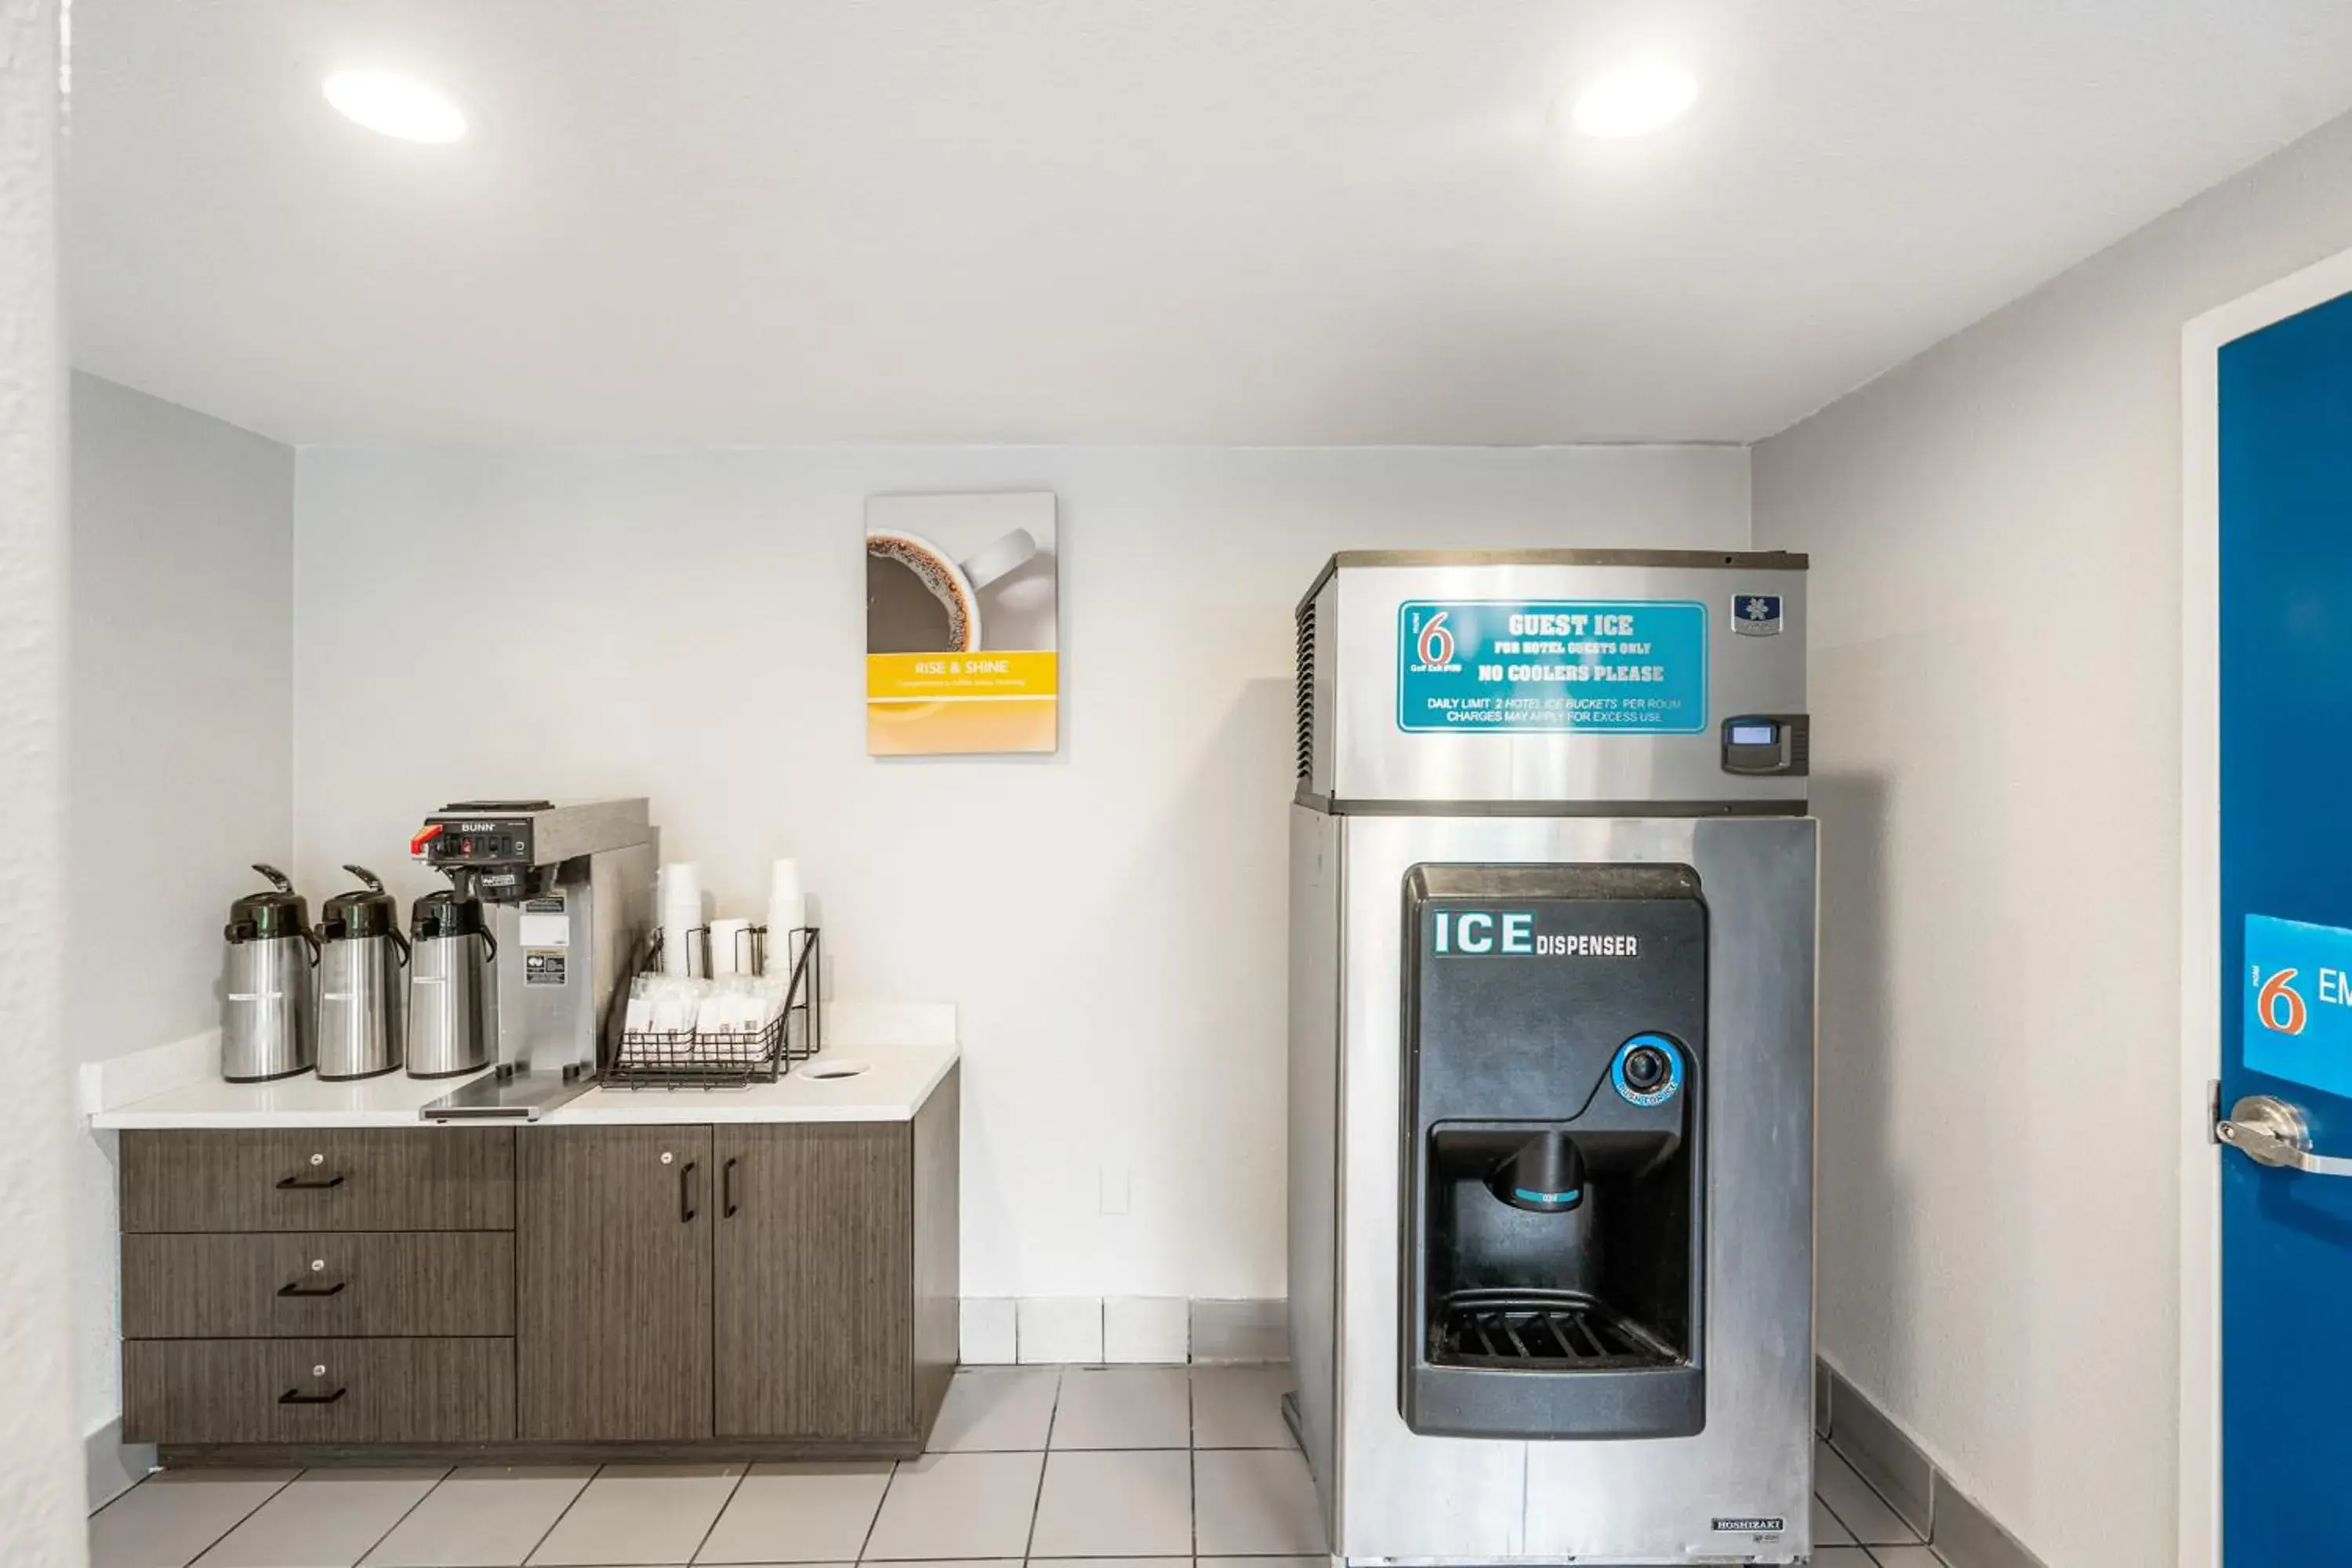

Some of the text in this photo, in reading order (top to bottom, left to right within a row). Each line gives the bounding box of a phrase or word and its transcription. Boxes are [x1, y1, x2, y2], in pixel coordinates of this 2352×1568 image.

[1509, 615, 1634, 635] GUEST ICE
[1417, 612, 1454, 665] 6
[1494, 641, 1651, 654] FOR HOTEL GUESTS ONLY
[915, 660, 1009, 675] RISE & SHINE
[1478, 664, 1503, 681] NO
[1508, 664, 1589, 681] COOLERS
[1594, 664, 1664, 682] PLEASE
[1427, 698, 1459, 710] DAILY
[1494, 699, 1502, 709] 2
[1504, 699, 1539, 709] HOTEL
[1566, 699, 1617, 710] BUCKETS
[1622, 699, 1645, 709] PER
[1647, 699, 1681, 710] ROOM
[1446, 710, 1503, 722] CHARGES
[1504, 711, 1528, 721] MAY
[1567, 711, 1590, 722] FOR
[1592, 712, 1638, 722] EXCESS
[1639, 712, 1662, 722] USE
[461, 823, 494, 832] BUNN
[1435, 913, 1638, 956] ICE DISPENSER
[2257, 968, 2307, 1035] 6
[1717, 1521, 1780, 1530] HOSHIZAKI
